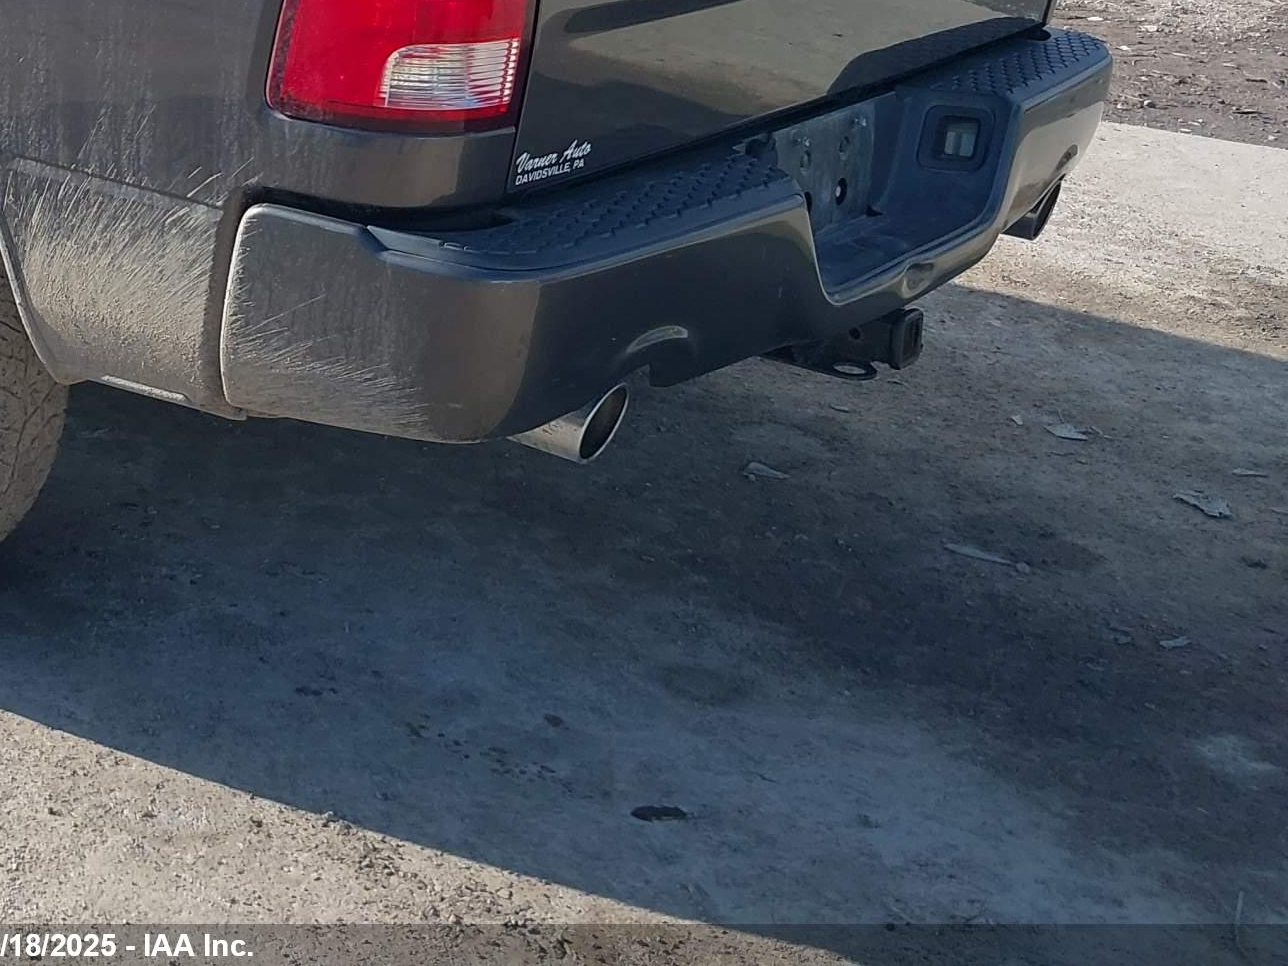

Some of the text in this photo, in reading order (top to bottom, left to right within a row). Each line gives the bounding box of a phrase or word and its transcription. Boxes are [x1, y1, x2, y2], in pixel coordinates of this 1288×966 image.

[516, 139, 591, 174] Varner Auto
[573, 158, 585, 170] PA
